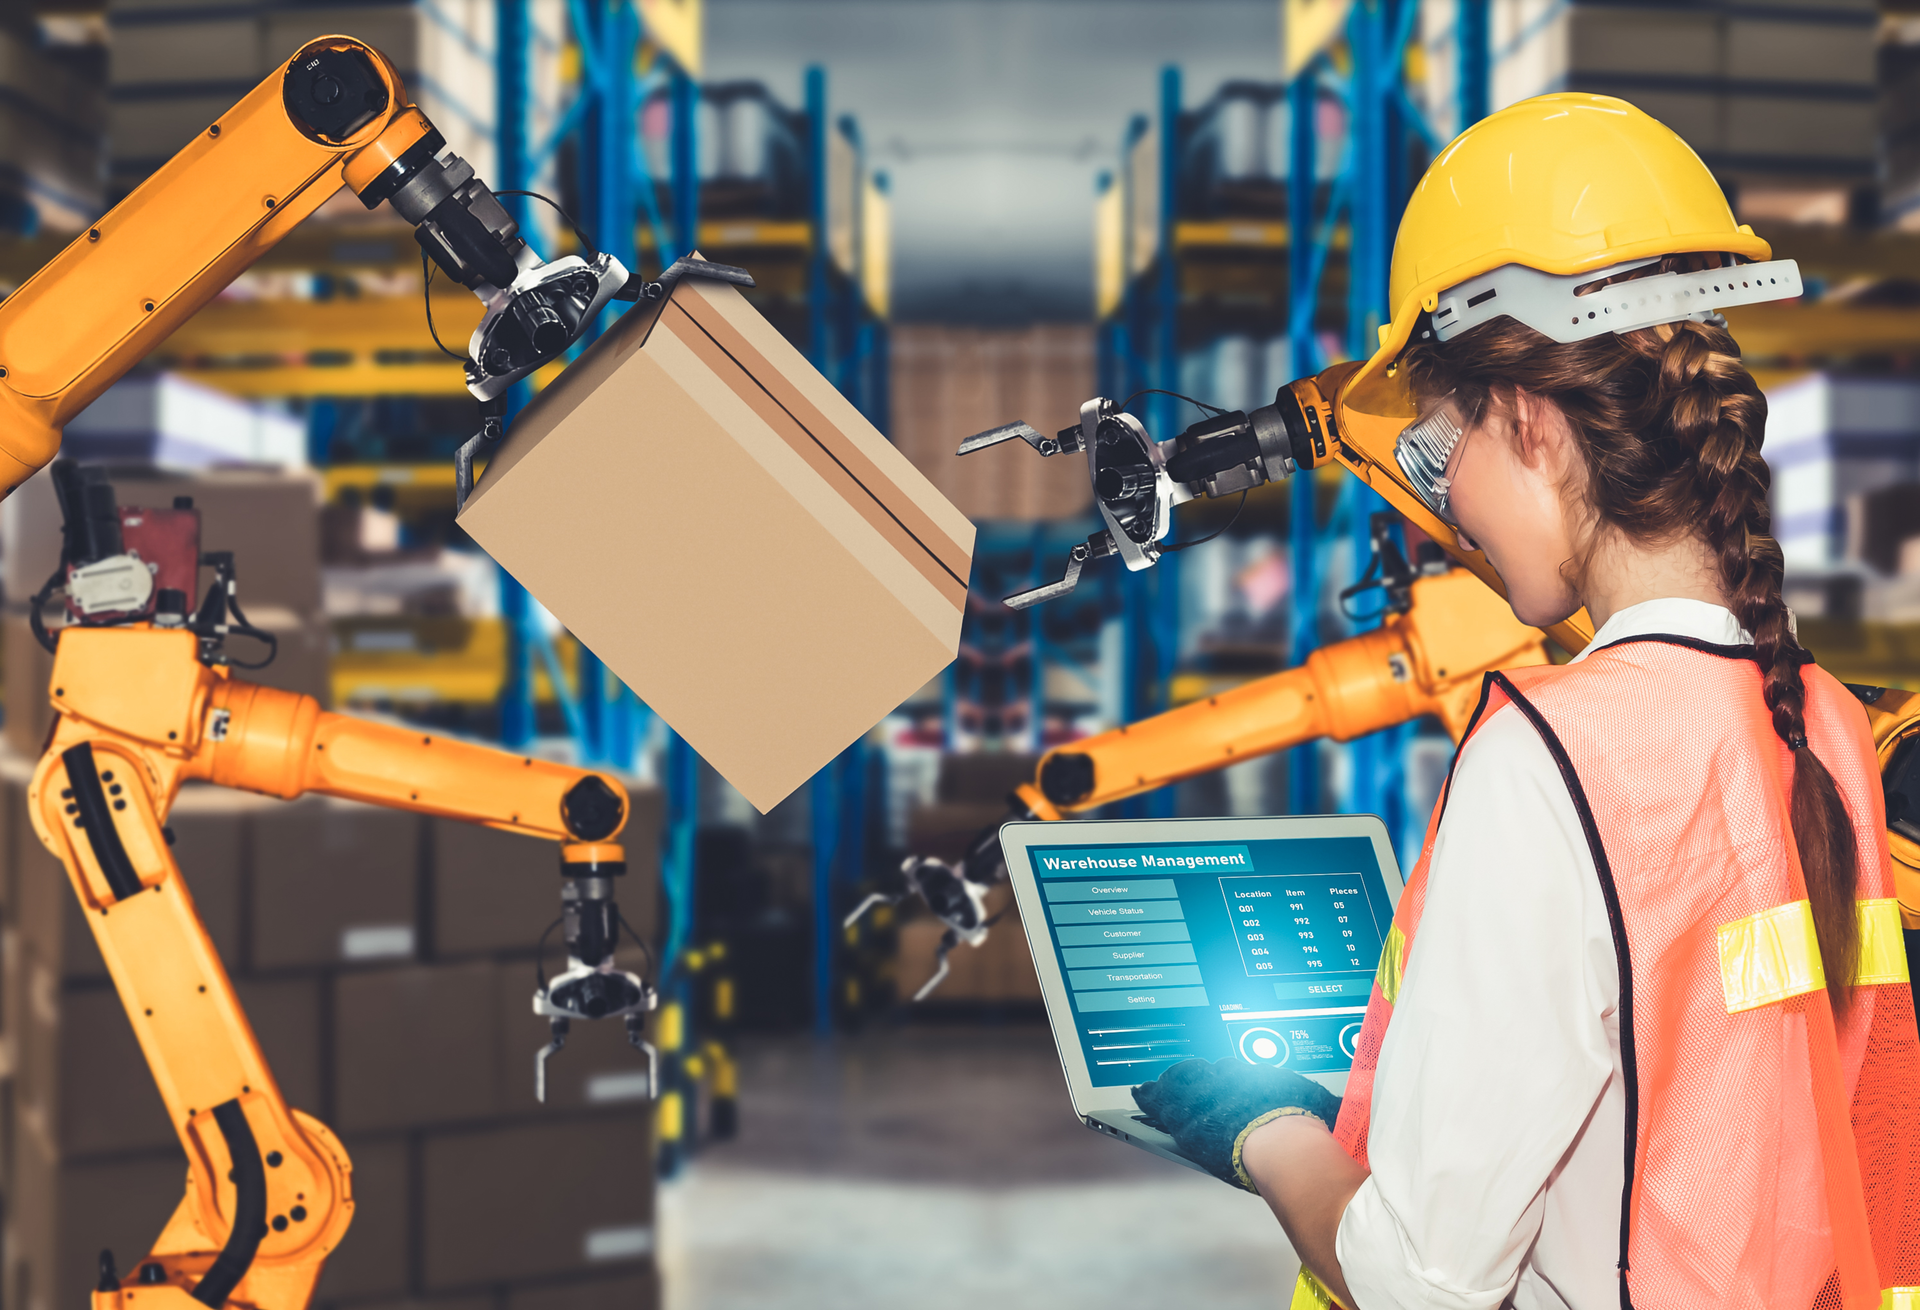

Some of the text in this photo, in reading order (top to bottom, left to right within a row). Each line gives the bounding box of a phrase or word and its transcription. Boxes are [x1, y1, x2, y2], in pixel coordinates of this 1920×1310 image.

[1043, 853, 1245, 870] Warehouse Management
[1091, 886, 1129, 894] Overview
[1234, 890, 1272, 899] Location
[1285, 889, 1306, 897] Item
[1087, 907, 1144, 916] Vehicle Status
[1238, 901, 1345, 913] Q01 991 05
[1242, 915, 1348, 927] Q02 992 07
[1103, 930, 1142, 938] Customer
[1246, 929, 1353, 942] Q03 993 09
[1251, 943, 1356, 956] Q04 994 10
[1112, 951, 1145, 960] Supplier
[1255, 958, 1360, 971] Q05 995 12
[1106, 972, 1164, 982] Transportation
[1307, 984, 1343, 994] SELECT
[1127, 995, 1156, 1004] Setting
[1289, 1029, 1310, 1040] 75%
